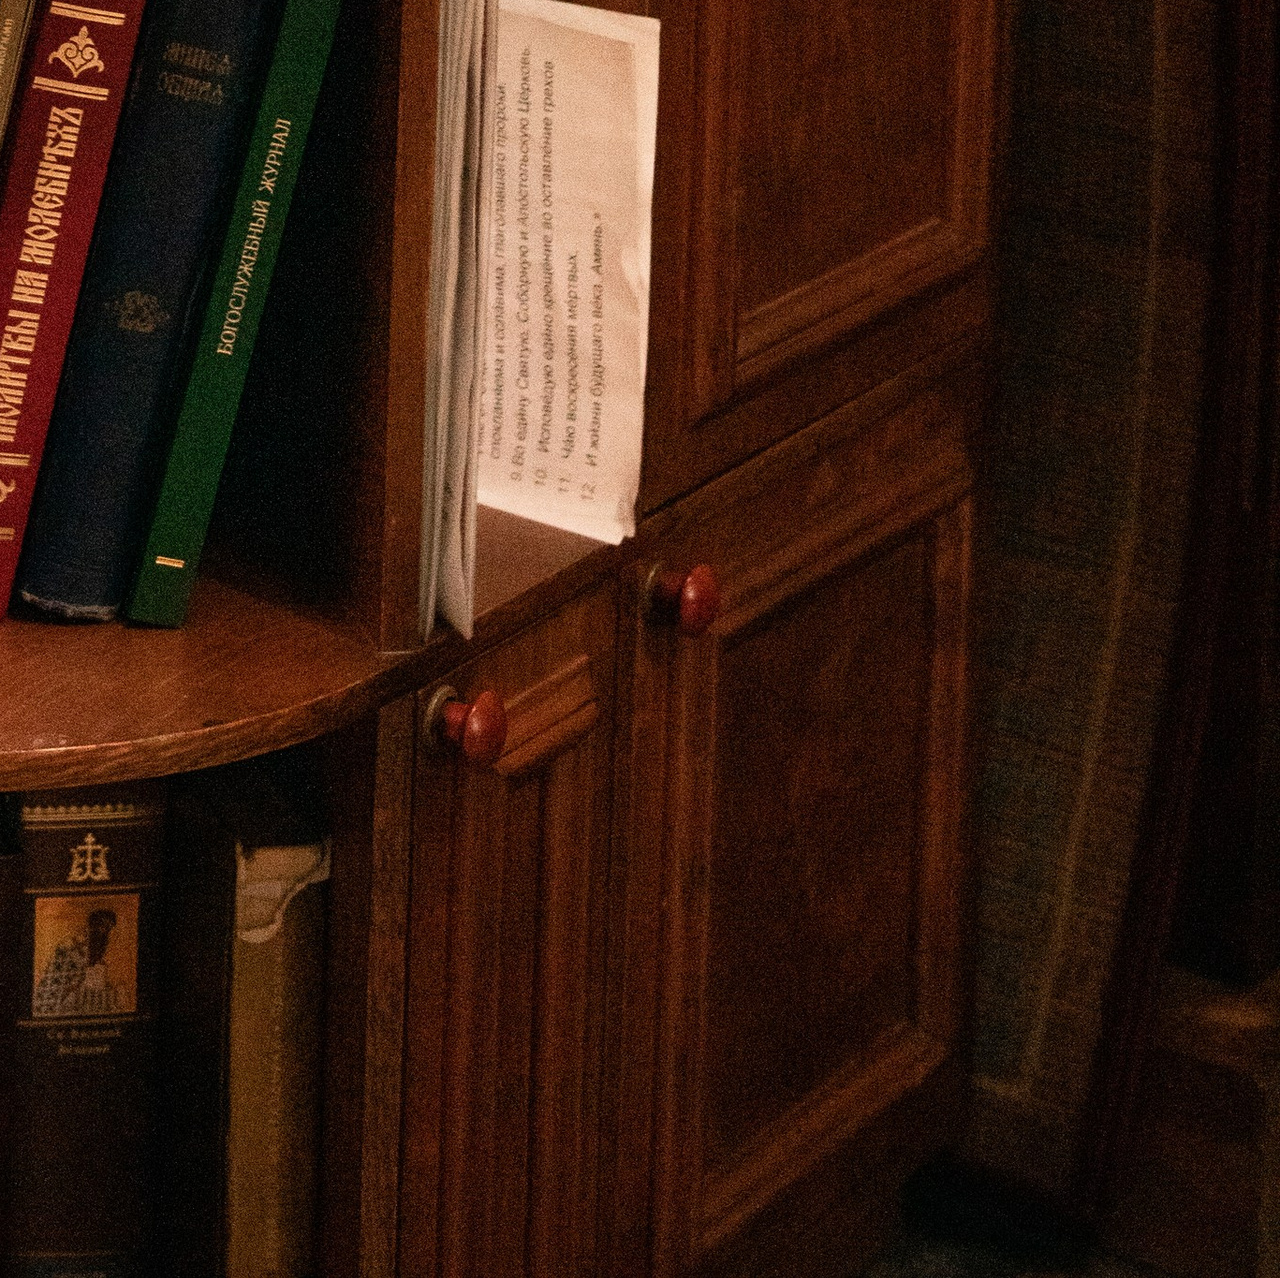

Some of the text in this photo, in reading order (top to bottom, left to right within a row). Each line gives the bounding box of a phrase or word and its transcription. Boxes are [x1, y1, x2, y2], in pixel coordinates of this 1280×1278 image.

[216, 118, 291, 357] БОГОСЛУЖЕБНЫЙ ЖУРНАЛ
[11, 269, 50, 306] НА
[585, 453, 598, 467] И
